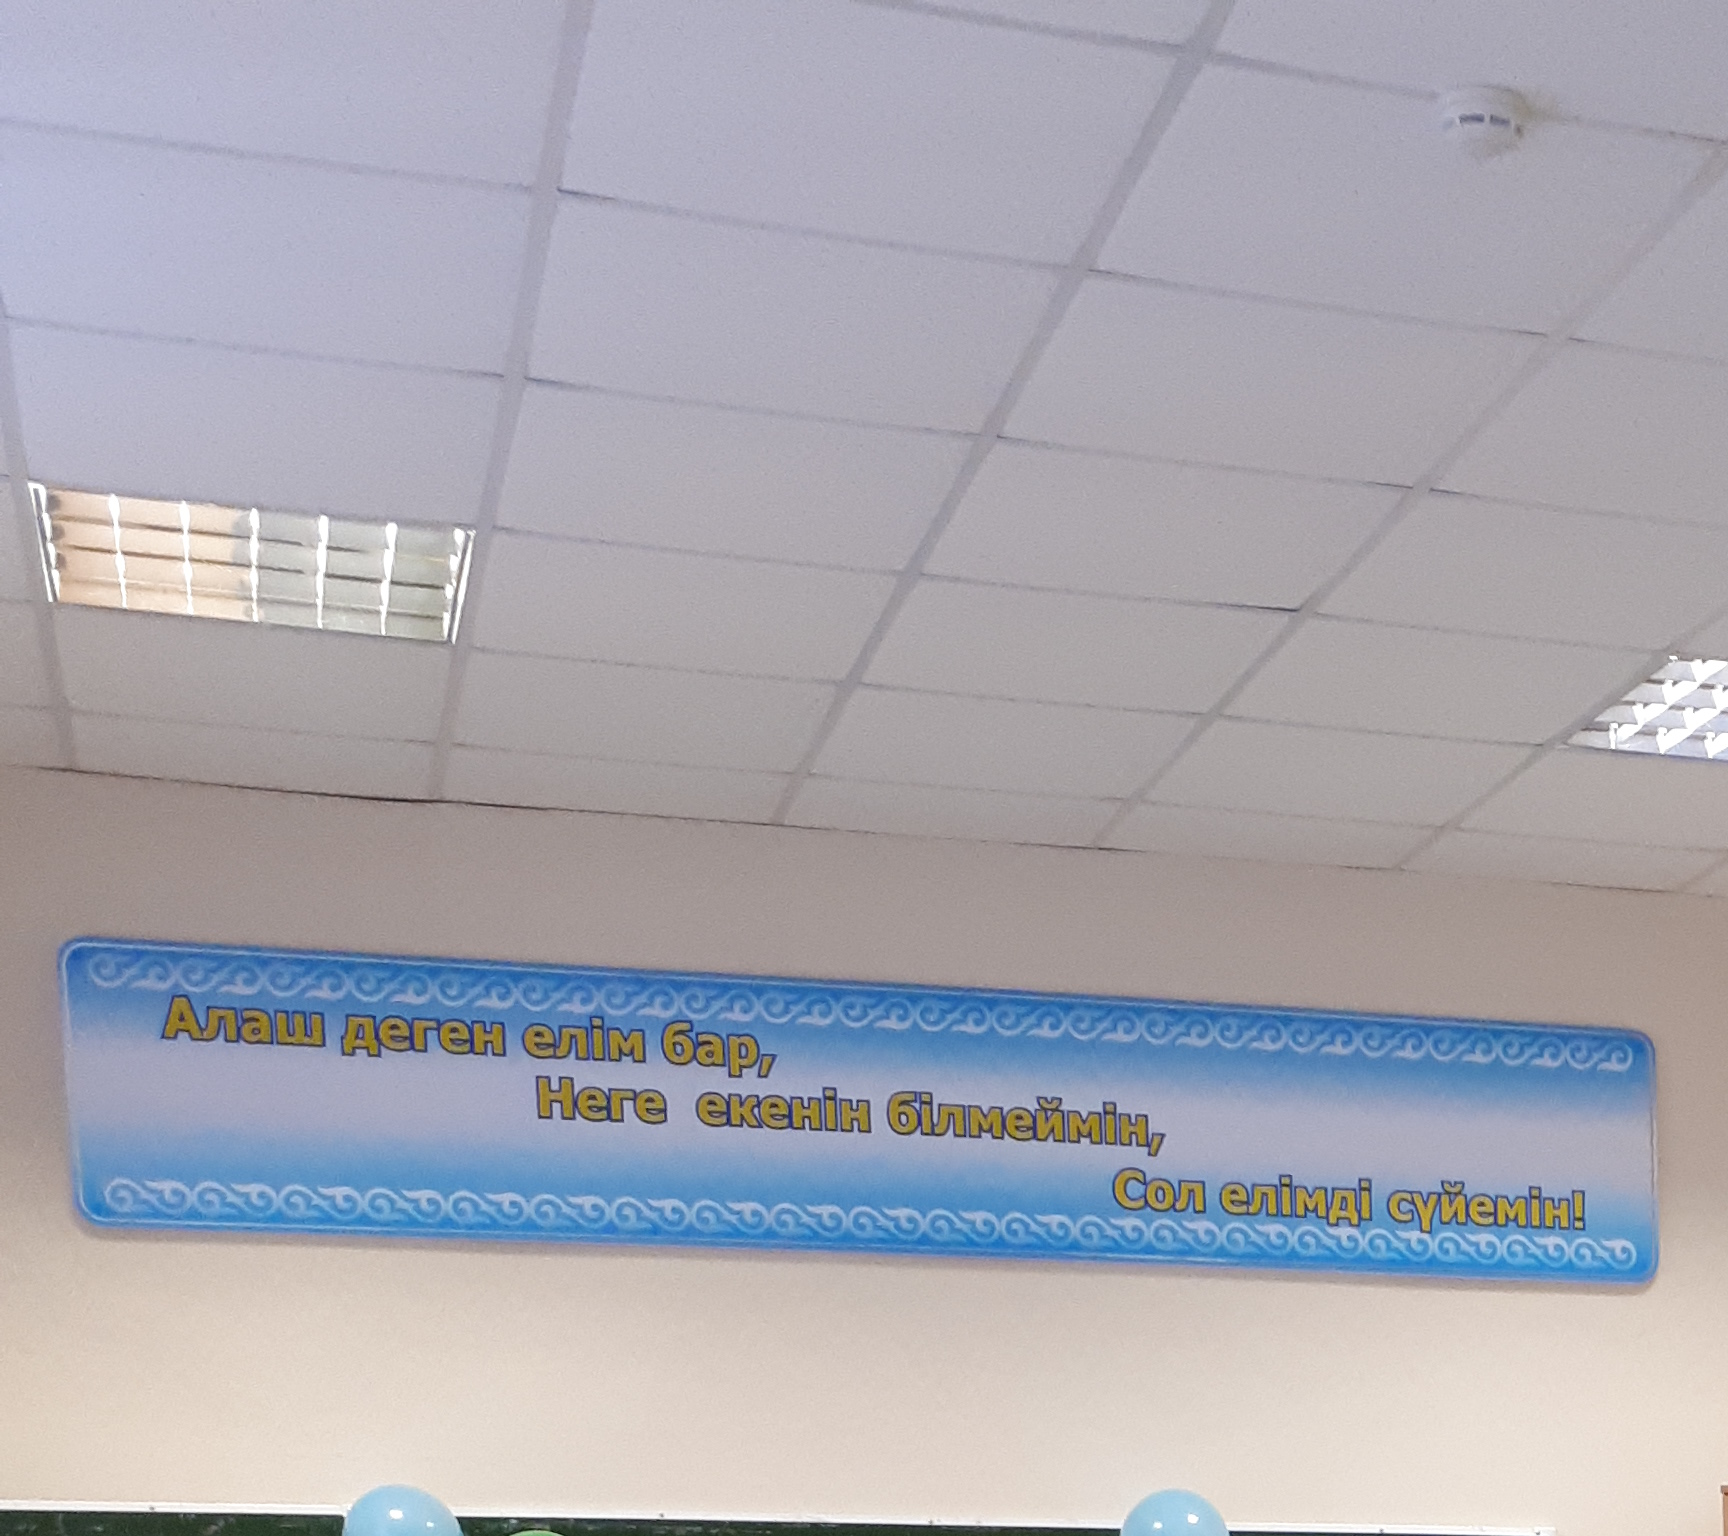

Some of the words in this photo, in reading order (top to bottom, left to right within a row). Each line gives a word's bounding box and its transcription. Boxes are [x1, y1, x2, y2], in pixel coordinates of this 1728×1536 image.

[162, 995, 326, 1048] Алаш
[342, 1013, 506, 1060] деген
[523, 1018, 646, 1064] елім
[661, 1020, 778, 1079] бар,
[536, 1075, 668, 1125] Неге
[695, 1088, 872, 1135] екенін
[887, 1091, 1166, 1158] білмеймін,
[1112, 1168, 1207, 1214] Сол
[1219, 1174, 1373, 1230] елімді
[1387, 1180, 1587, 1235] сүйемін!
